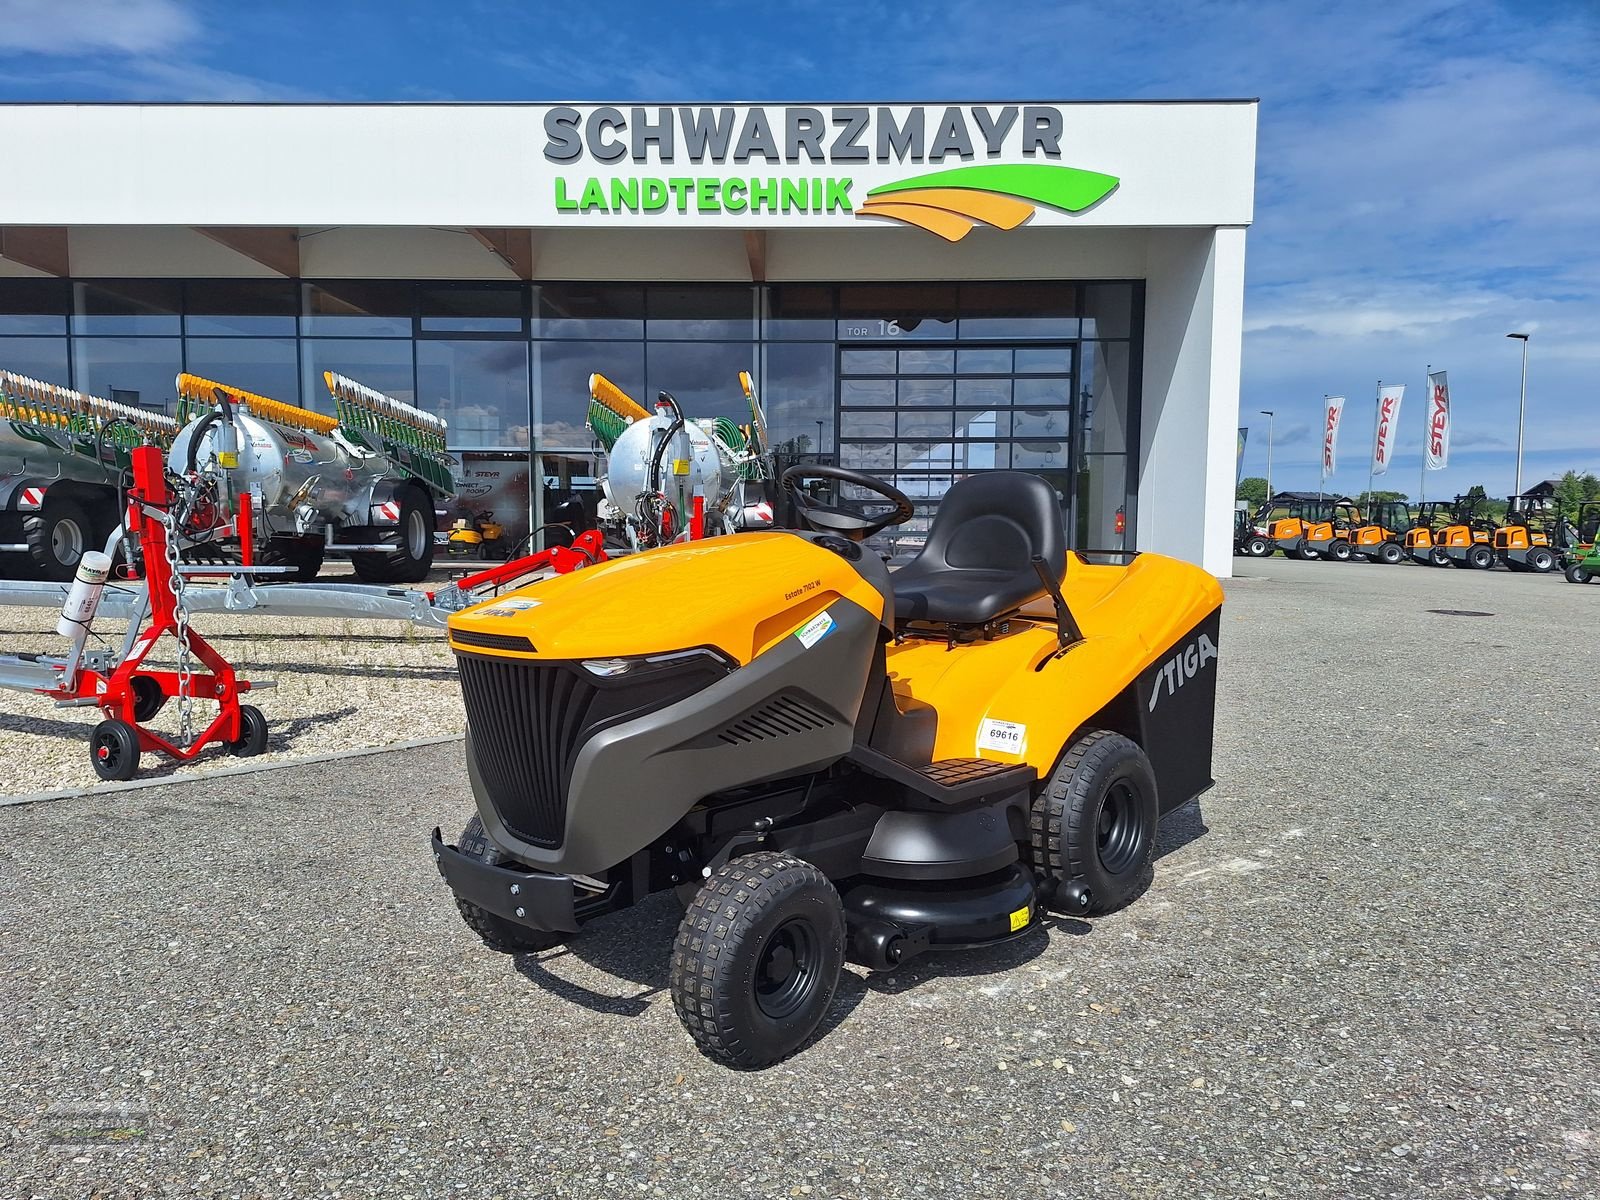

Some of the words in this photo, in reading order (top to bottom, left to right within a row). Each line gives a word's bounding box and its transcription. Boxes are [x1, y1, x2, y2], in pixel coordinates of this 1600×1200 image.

[543, 105, 1063, 161] SCHWARZMAYR
[554, 176, 854, 214] LANDTECHNIK
[847, 327, 868, 336] TOR
[878, 319, 901, 336] 16
[1324, 406, 1338, 469] STEYR
[1375, 396, 1394, 464] STEYR
[1431, 384, 1447, 457] STEYR
[786, 588, 803, 601] Estate
[803, 583, 815, 592] 7102
[816, 579, 822, 587] W
[1148, 633, 1218, 713] STIGA
[990, 729, 1019, 741] 69616
